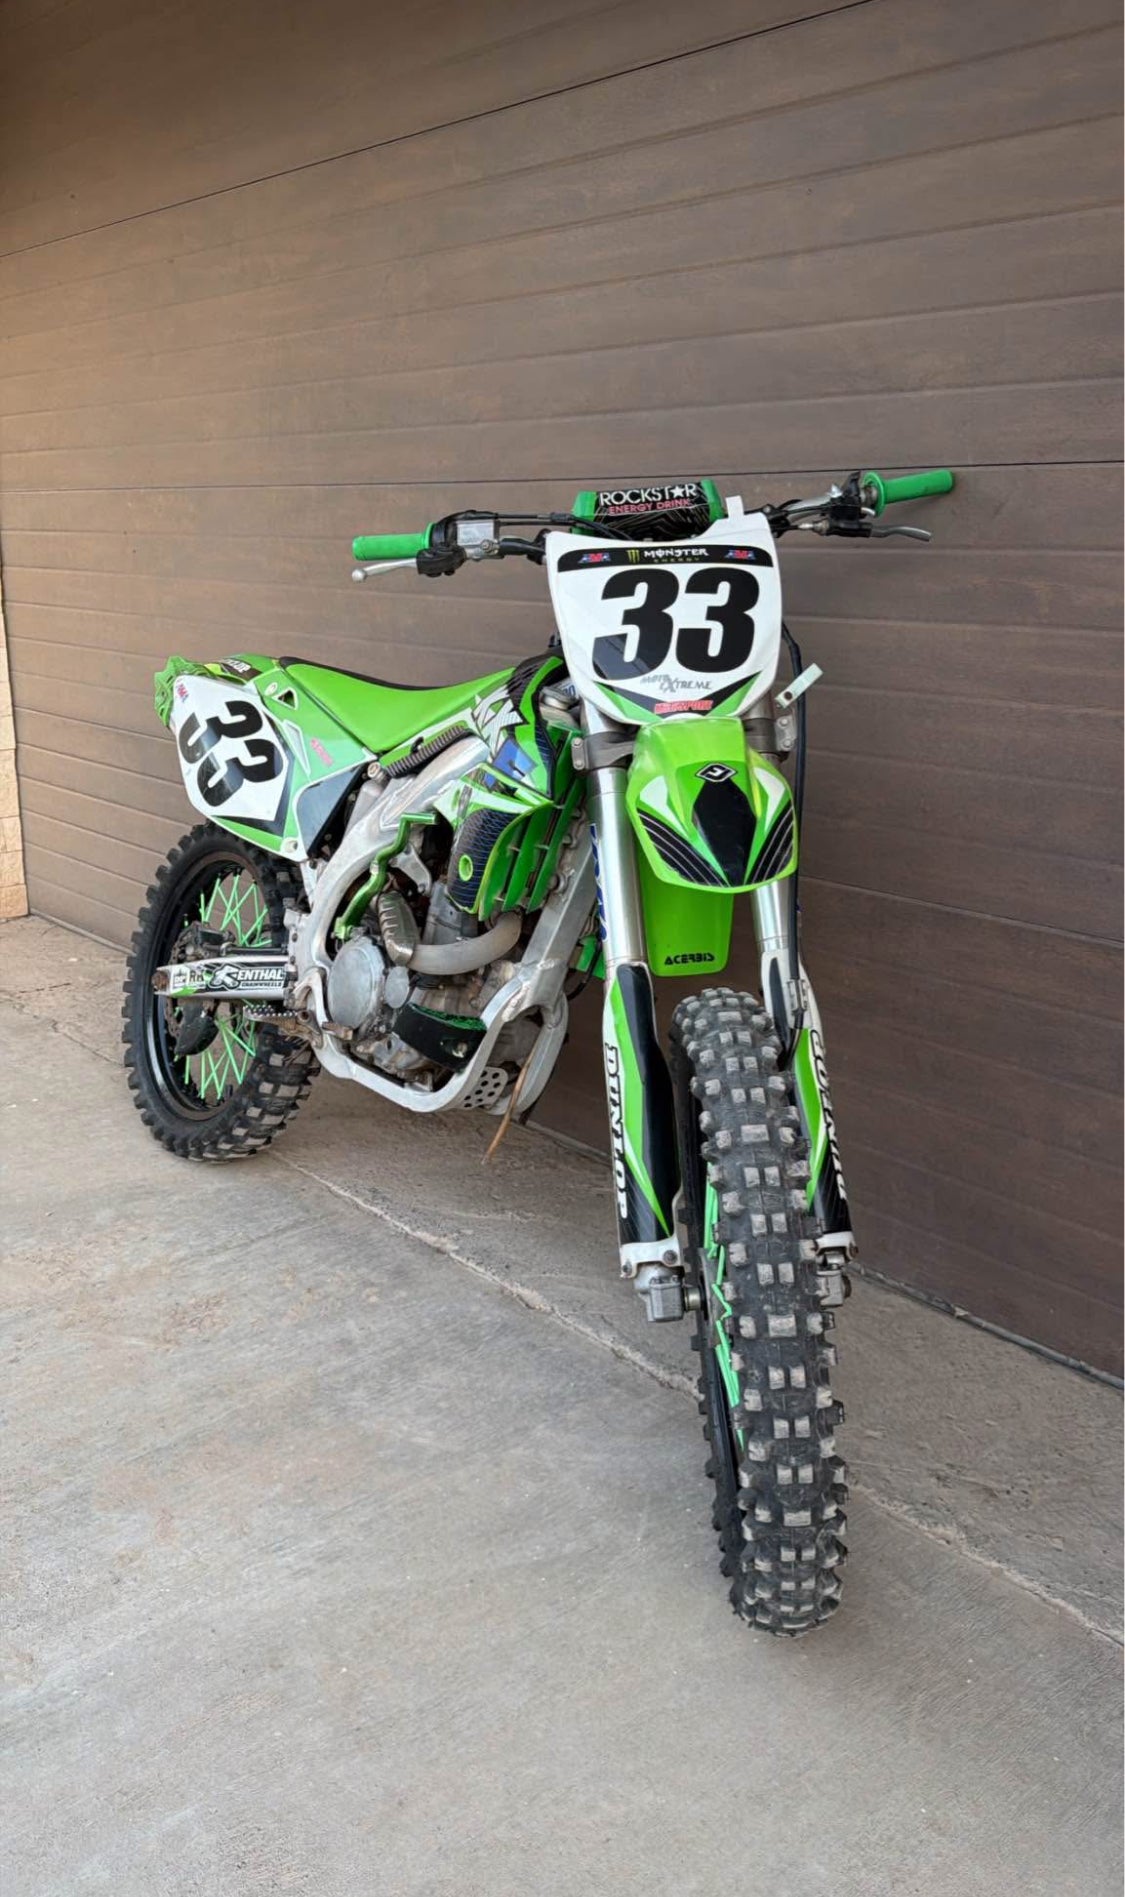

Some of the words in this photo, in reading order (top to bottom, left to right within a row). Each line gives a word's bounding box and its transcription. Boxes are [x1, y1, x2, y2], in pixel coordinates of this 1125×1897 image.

[608, 503, 653, 515] ENERGY
[656, 499, 692, 510] DRINK
[578, 552, 611, 564] AMA
[644, 547, 709, 558] MONSTER
[724, 549, 756, 560] AMA
[591, 567, 760, 680] 33
[179, 700, 284, 807] 33
[209, 964, 284, 990] RENTHAL
[604, 1042, 628, 1219] DUNLOP
